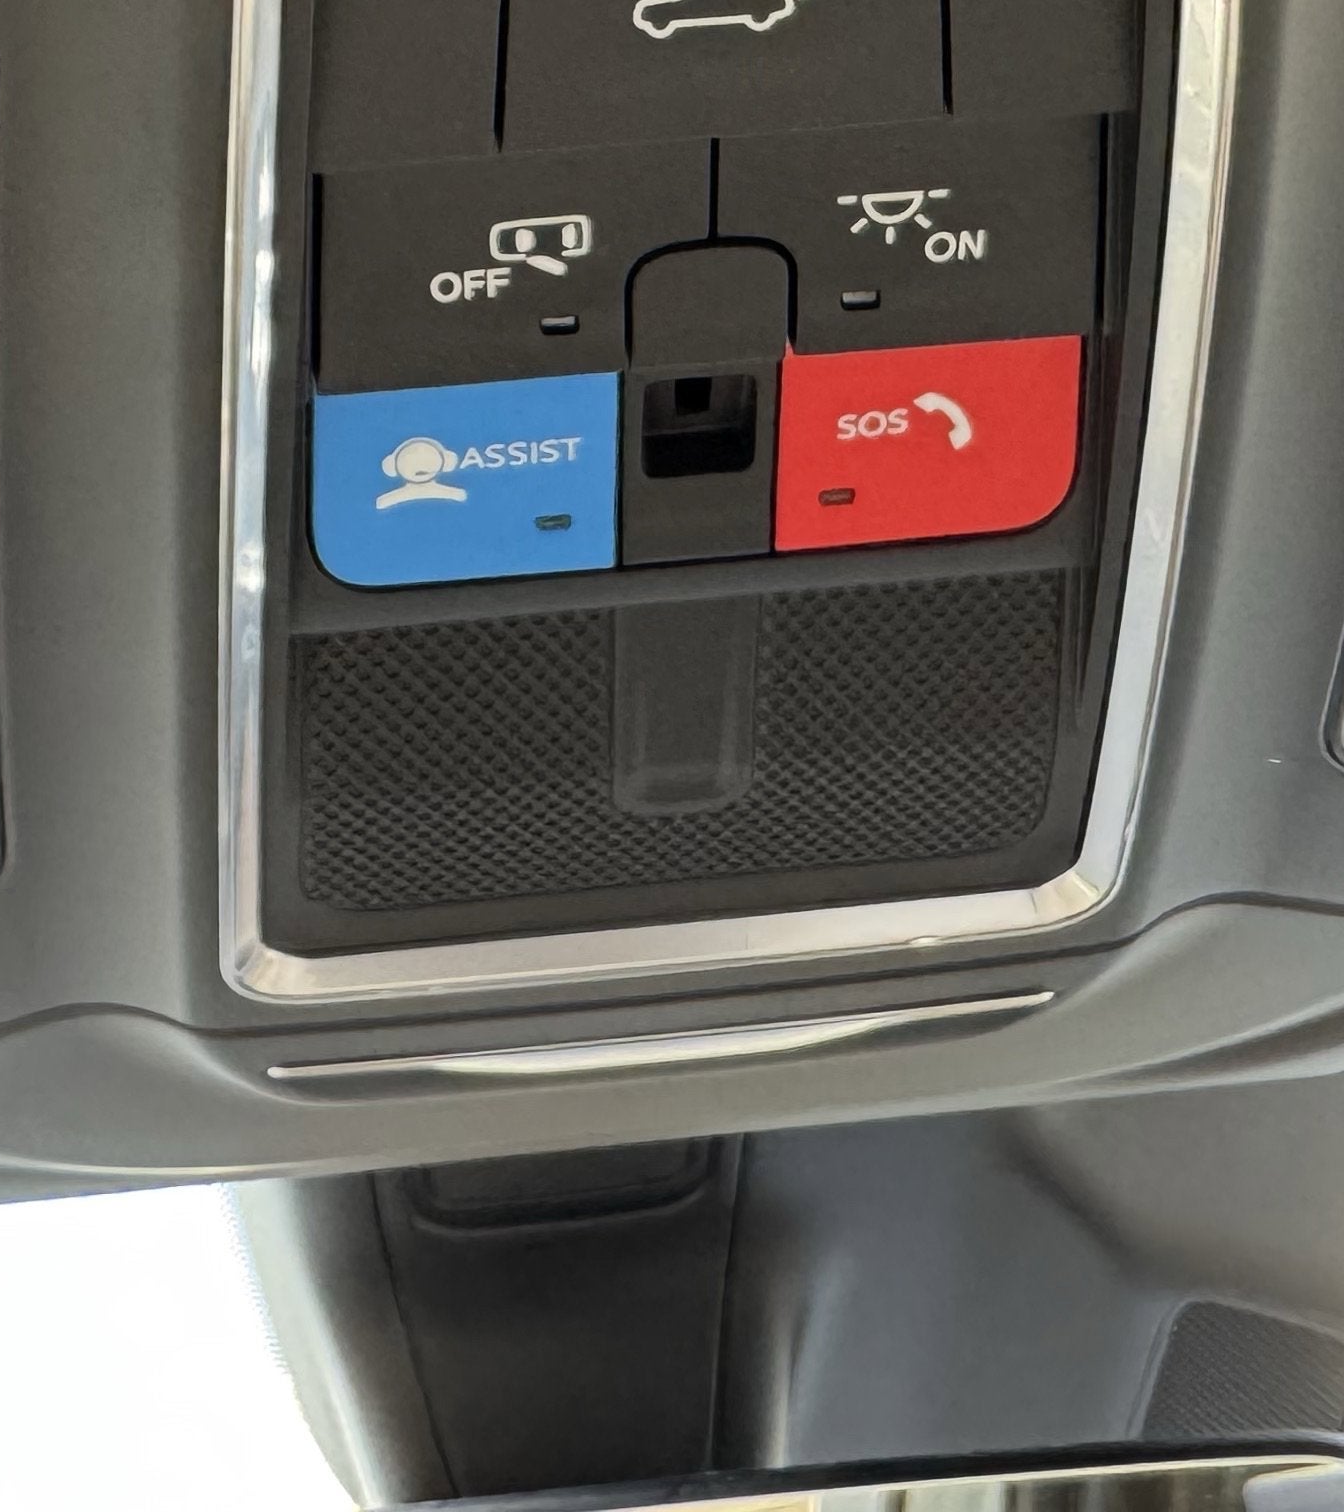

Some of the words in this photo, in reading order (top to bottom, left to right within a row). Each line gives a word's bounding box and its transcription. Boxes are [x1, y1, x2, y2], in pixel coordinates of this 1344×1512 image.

[924, 228, 987, 263] ON
[429, 266, 511, 304] OFF
[837, 408, 909, 440] SOS
[459, 437, 582, 470] ASSIST
